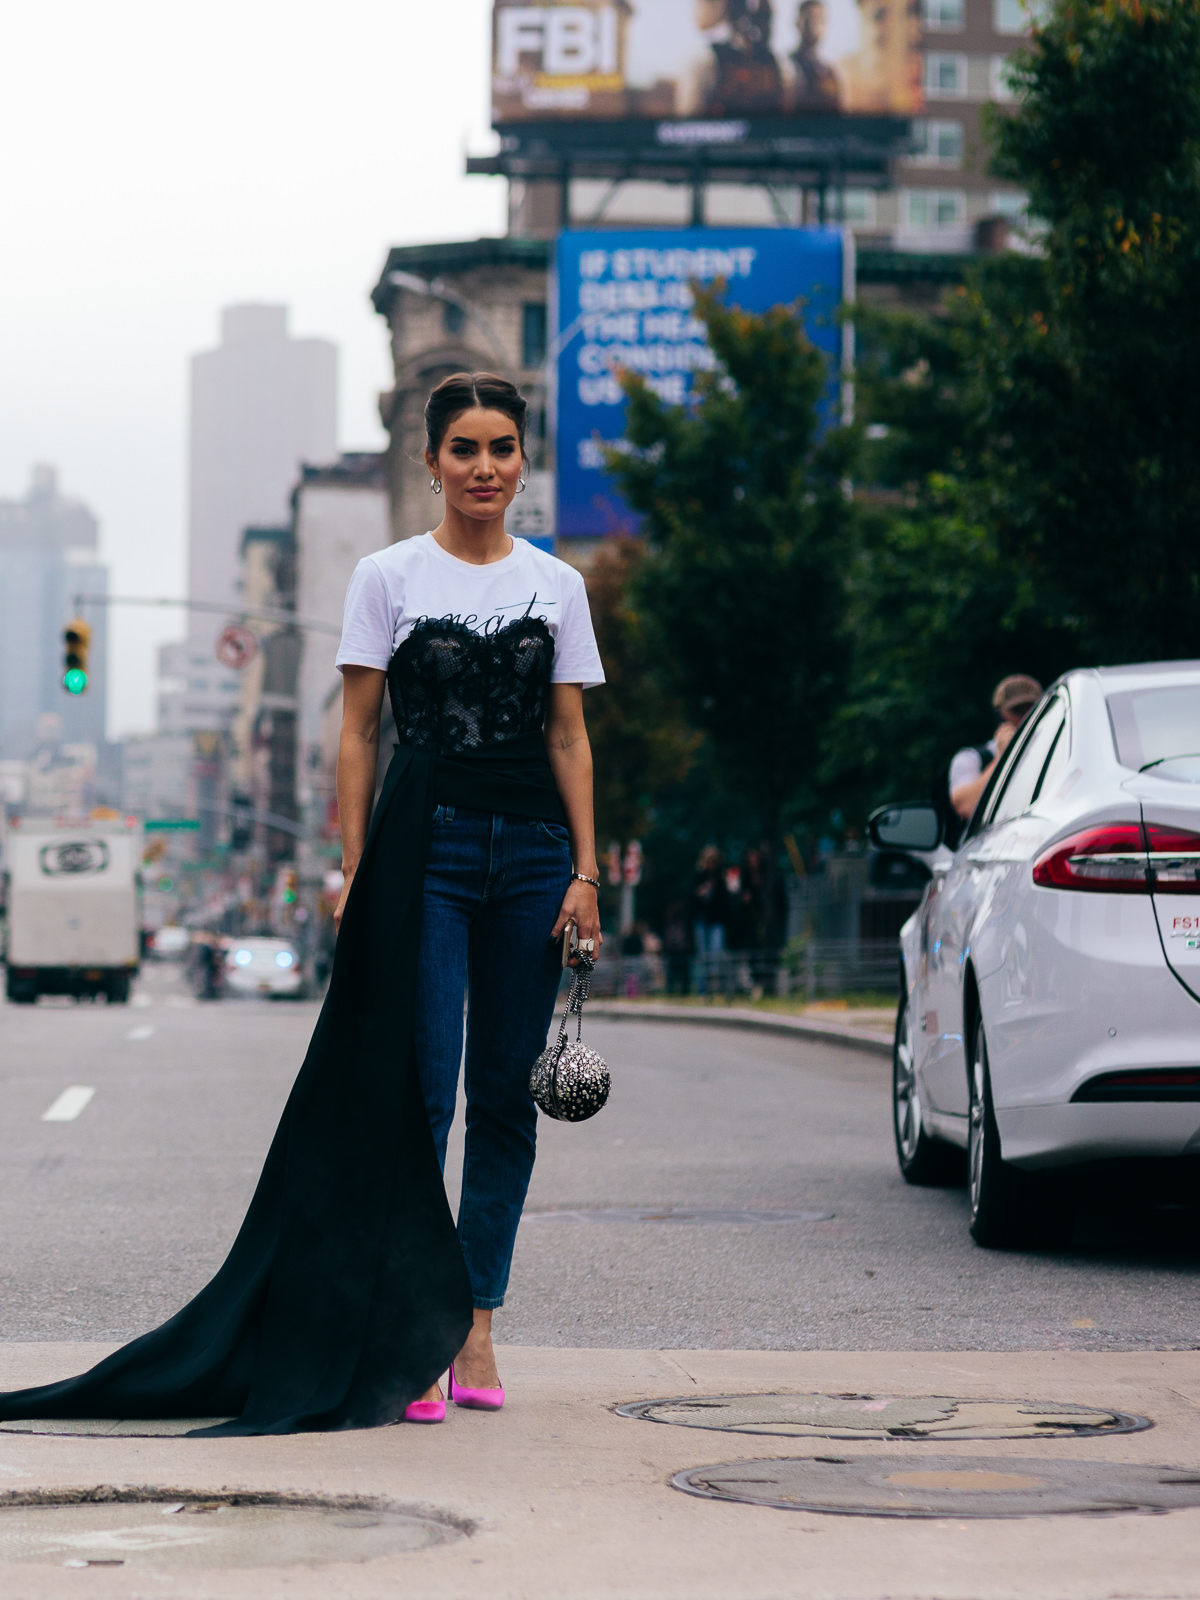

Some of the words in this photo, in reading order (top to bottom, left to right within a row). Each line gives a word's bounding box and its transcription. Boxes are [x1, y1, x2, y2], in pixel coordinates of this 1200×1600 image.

[496, 6, 618, 74] FBI
[579, 249, 608, 279] IF
[612, 247, 757, 279] STUDENT
[580, 311, 639, 342] THE
